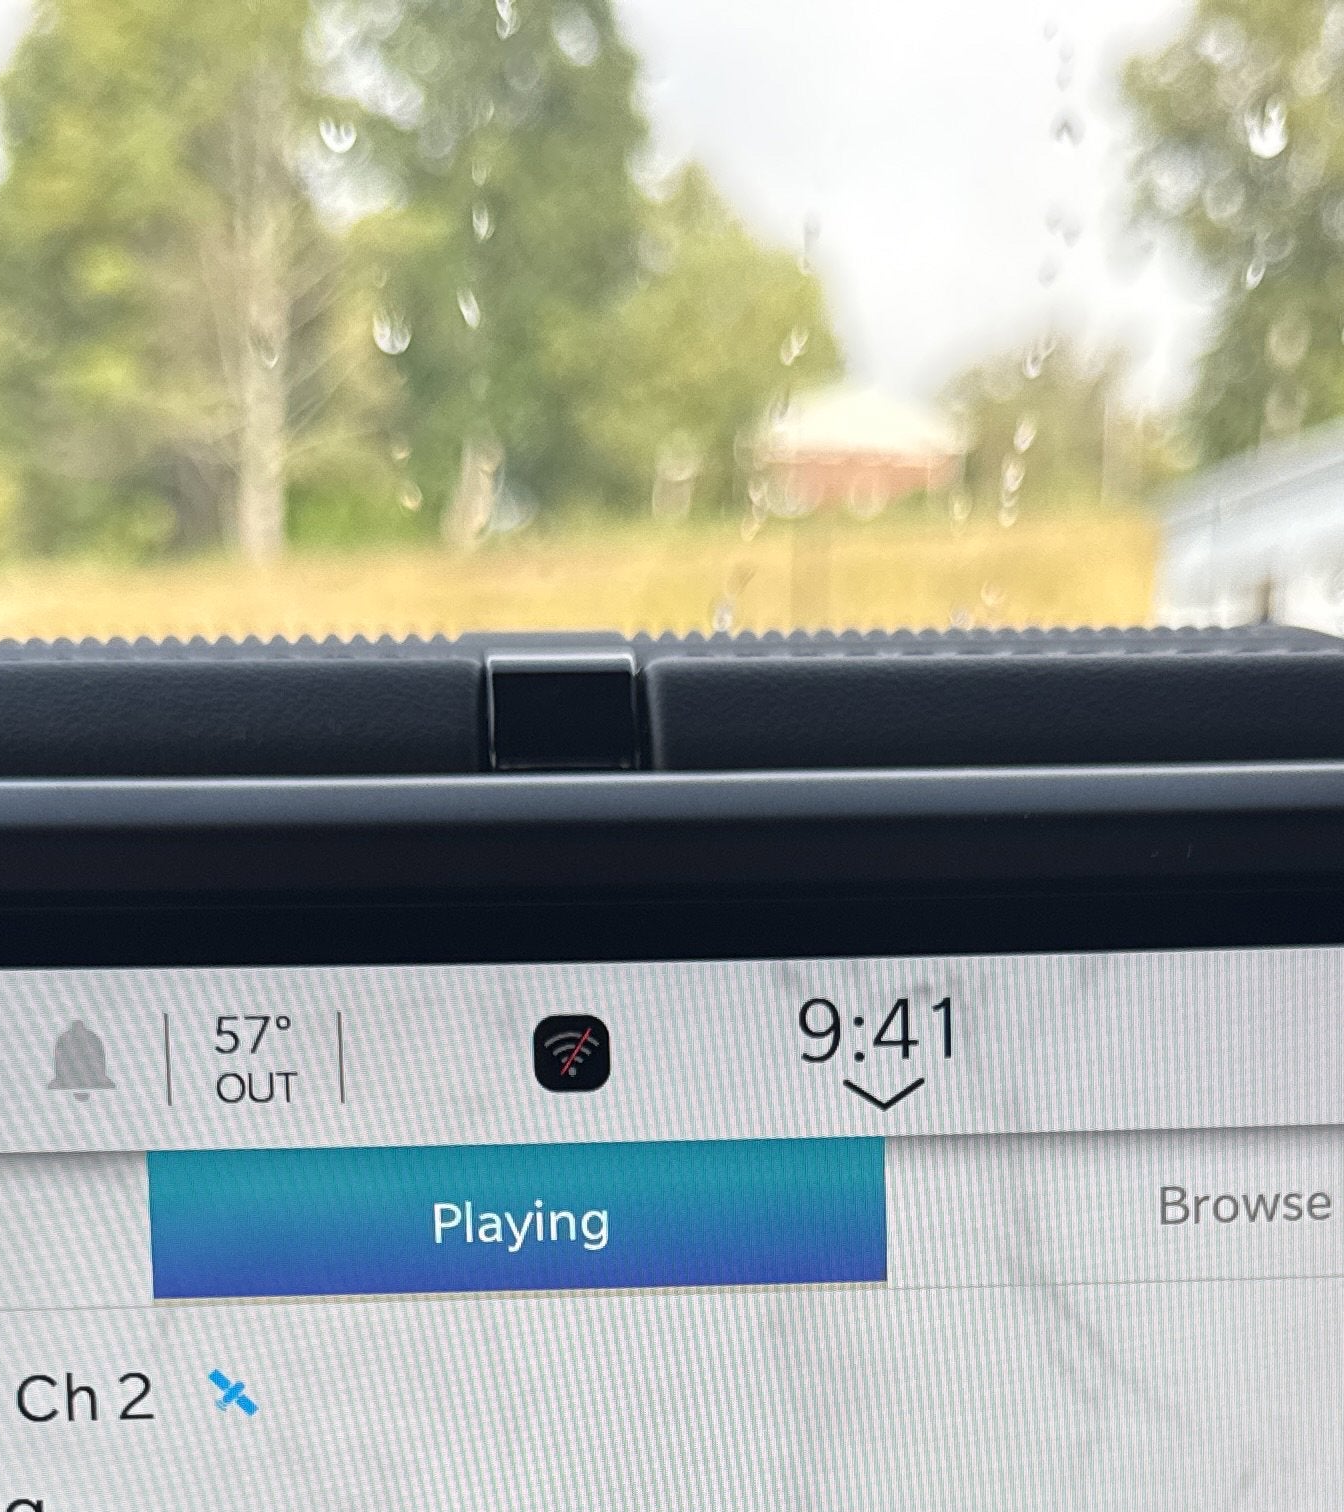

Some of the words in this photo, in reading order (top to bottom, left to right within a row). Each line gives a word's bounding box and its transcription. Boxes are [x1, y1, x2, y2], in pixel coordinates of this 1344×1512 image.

[798, 996, 953, 1063] 9:41
[215, 1072, 298, 1104] OUT
[433, 1200, 610, 1252] Playing
[1159, 1186, 1333, 1225] Browse
[16, 1372, 98, 1422] Ch
[118, 1372, 156, 1421] 2
